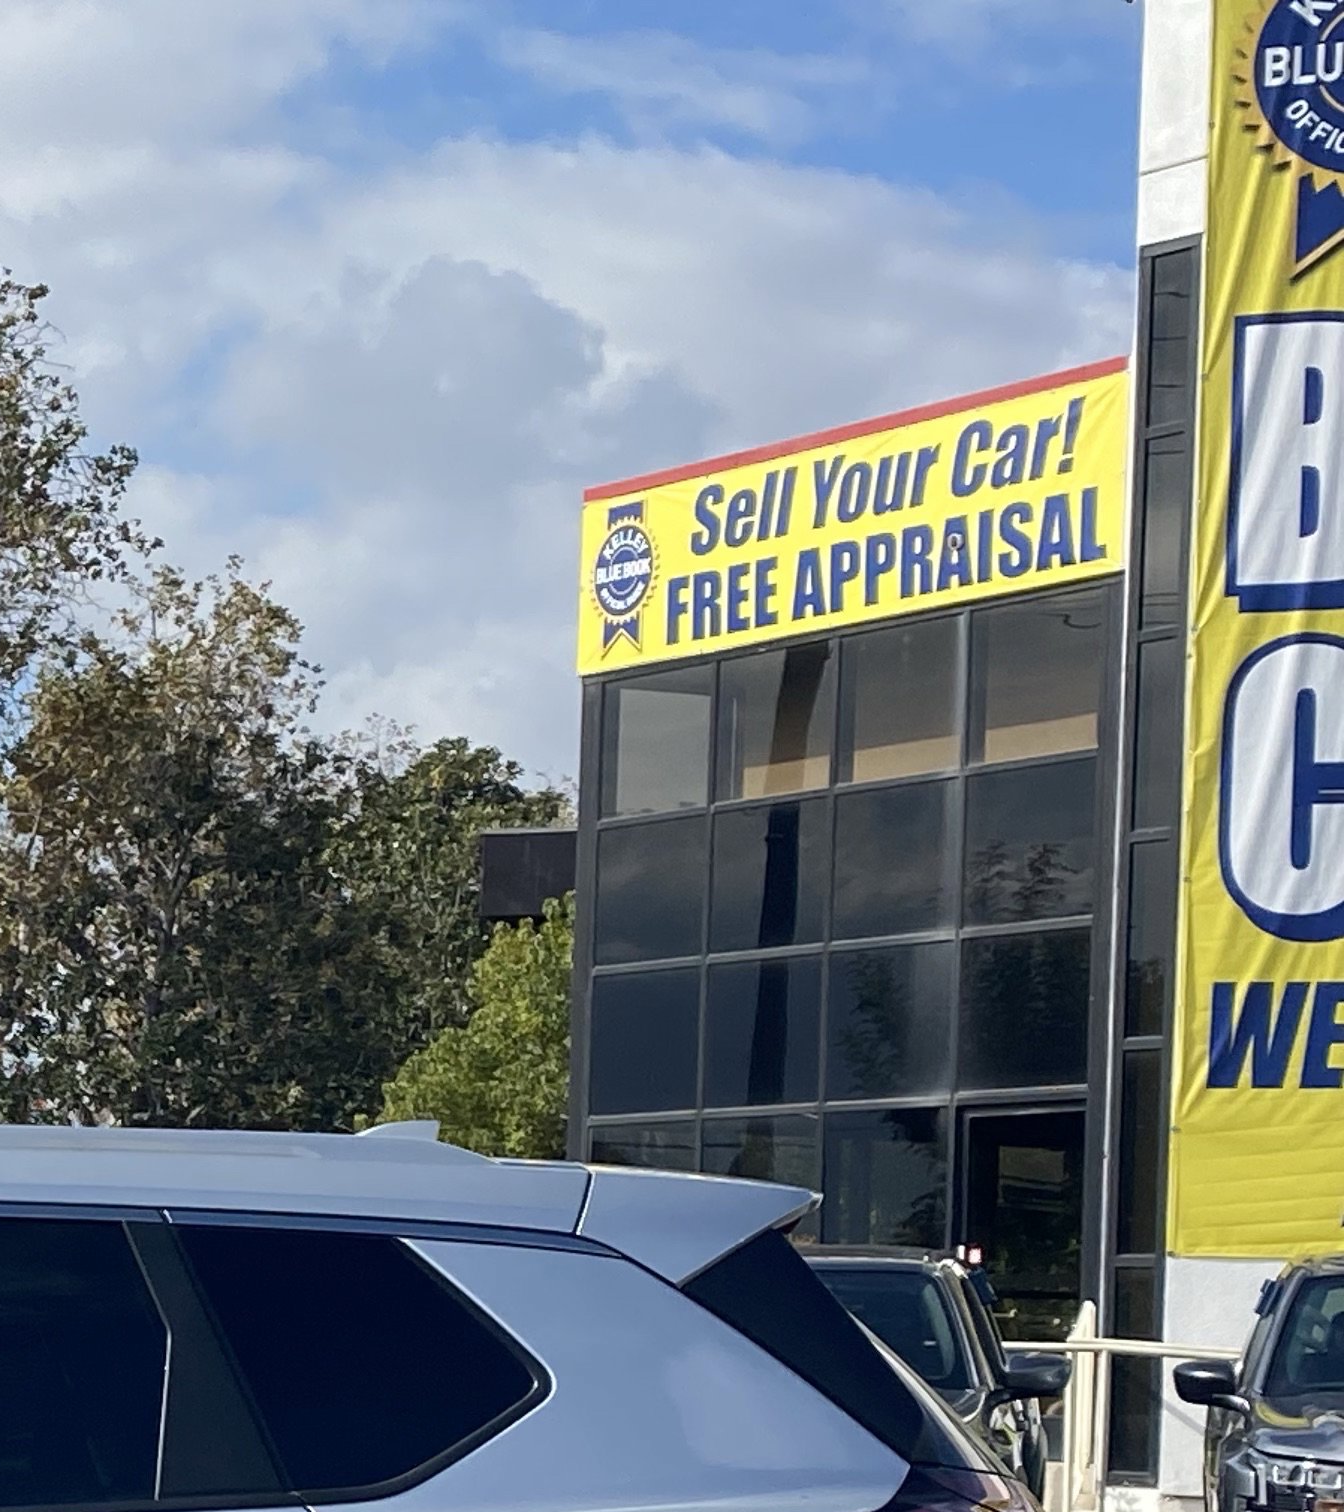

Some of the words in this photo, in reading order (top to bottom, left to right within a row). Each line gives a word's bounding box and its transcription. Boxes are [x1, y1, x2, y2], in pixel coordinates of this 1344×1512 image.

[690, 465, 798, 556] Sell
[812, 442, 941, 530] Your
[951, 395, 1086, 498] Car!
[596, 563, 623, 584] BLUE
[624, 558, 651, 577] BOOK
[603, 529, 648, 559] KELLEY
[665, 555, 780, 646] FREE
[791, 486, 1108, 622] APPRAISAL
